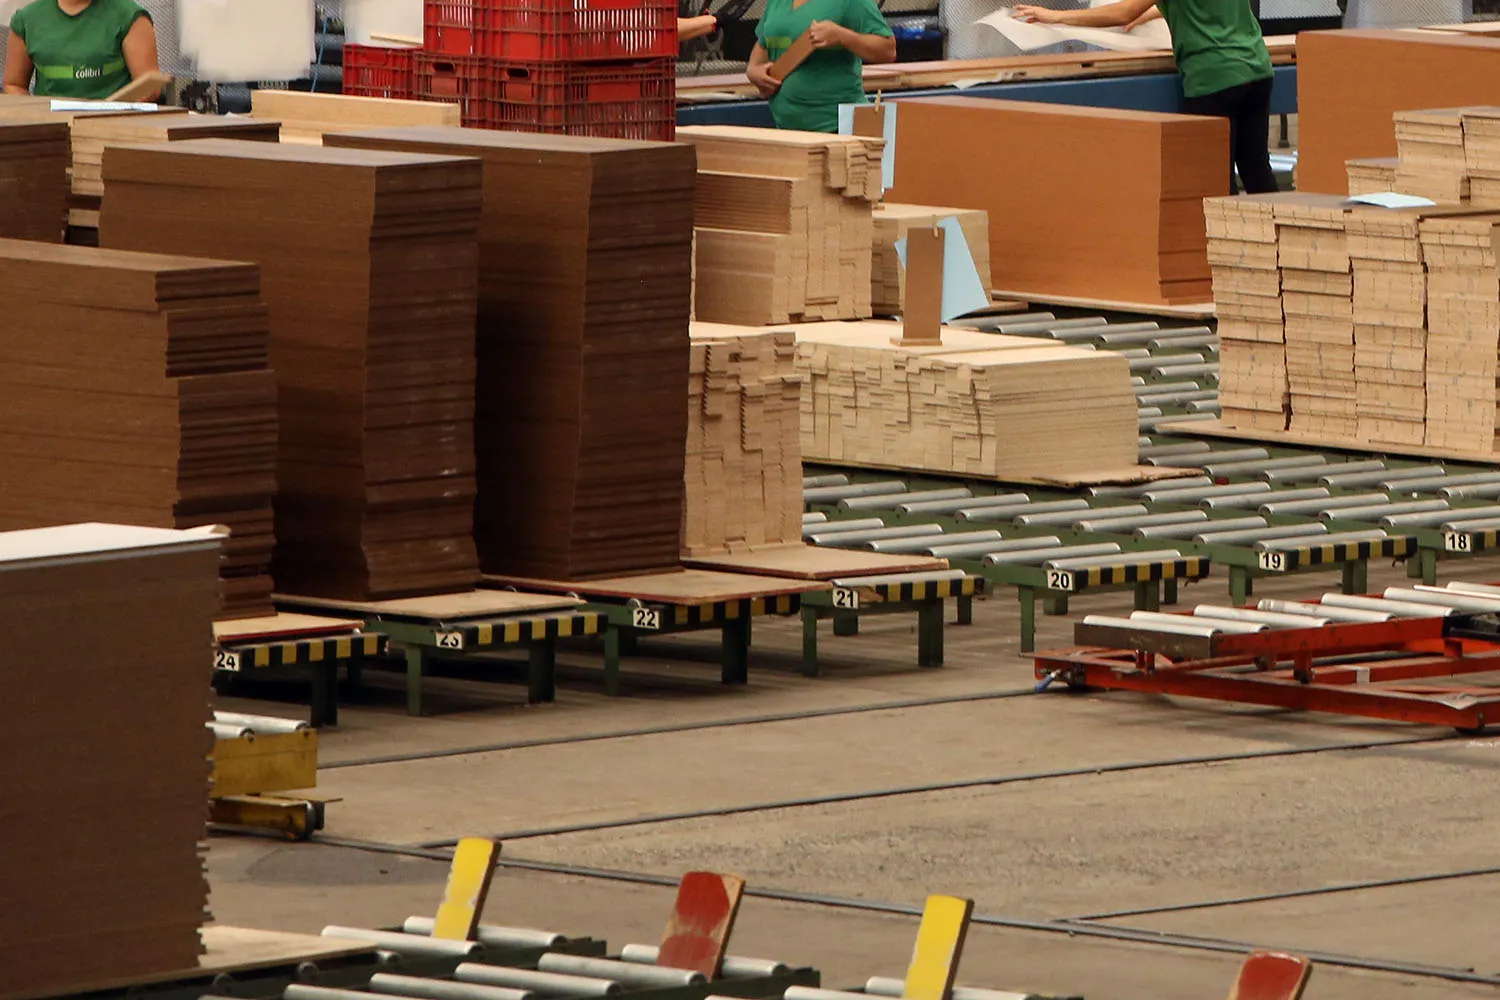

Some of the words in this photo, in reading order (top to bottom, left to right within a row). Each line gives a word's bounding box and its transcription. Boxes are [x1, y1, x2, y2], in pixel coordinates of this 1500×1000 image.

[75, 67, 101, 79] colibri
[1449, 534, 1467, 549] 18
[1263, 552, 1281, 569] 19
[1051, 572, 1069, 588] 20
[836, 590, 854, 607] 21
[636, 609, 655, 627] 22
[216, 650, 235, 669] 24
